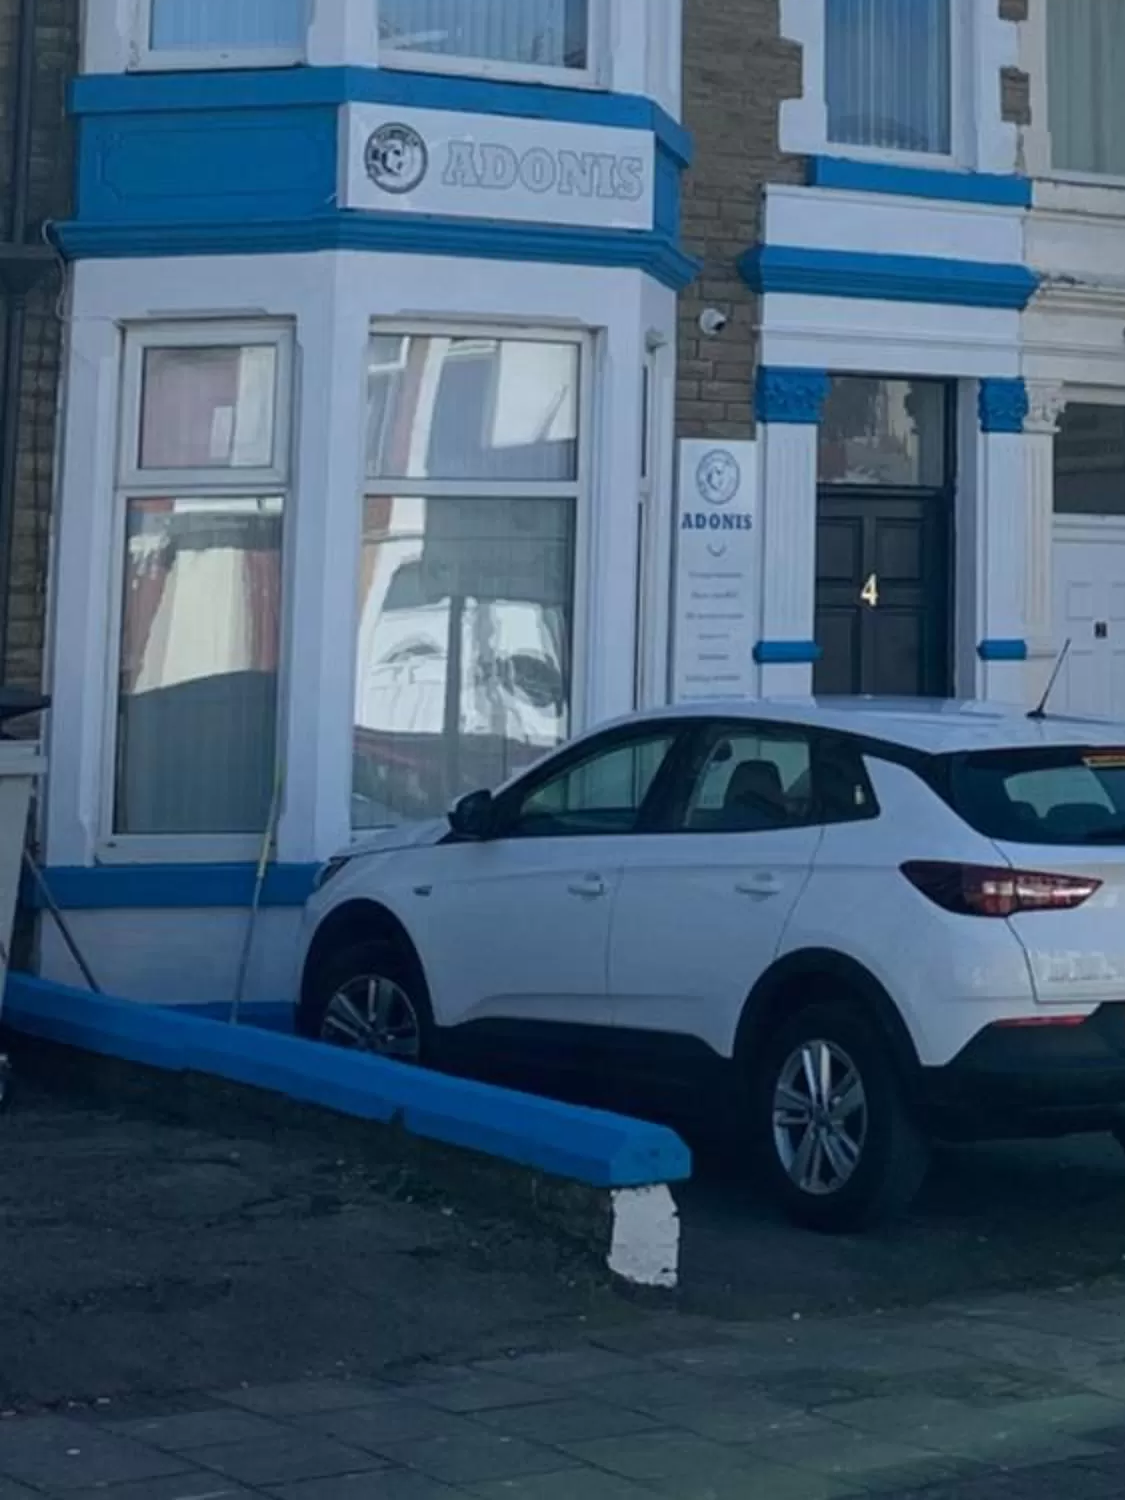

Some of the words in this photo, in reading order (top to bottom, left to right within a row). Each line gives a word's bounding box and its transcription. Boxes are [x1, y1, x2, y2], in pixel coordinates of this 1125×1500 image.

[441, 139, 645, 200] ADONIS
[681, 512, 752, 530] ADONIS
[860, 573, 879, 607] 4
